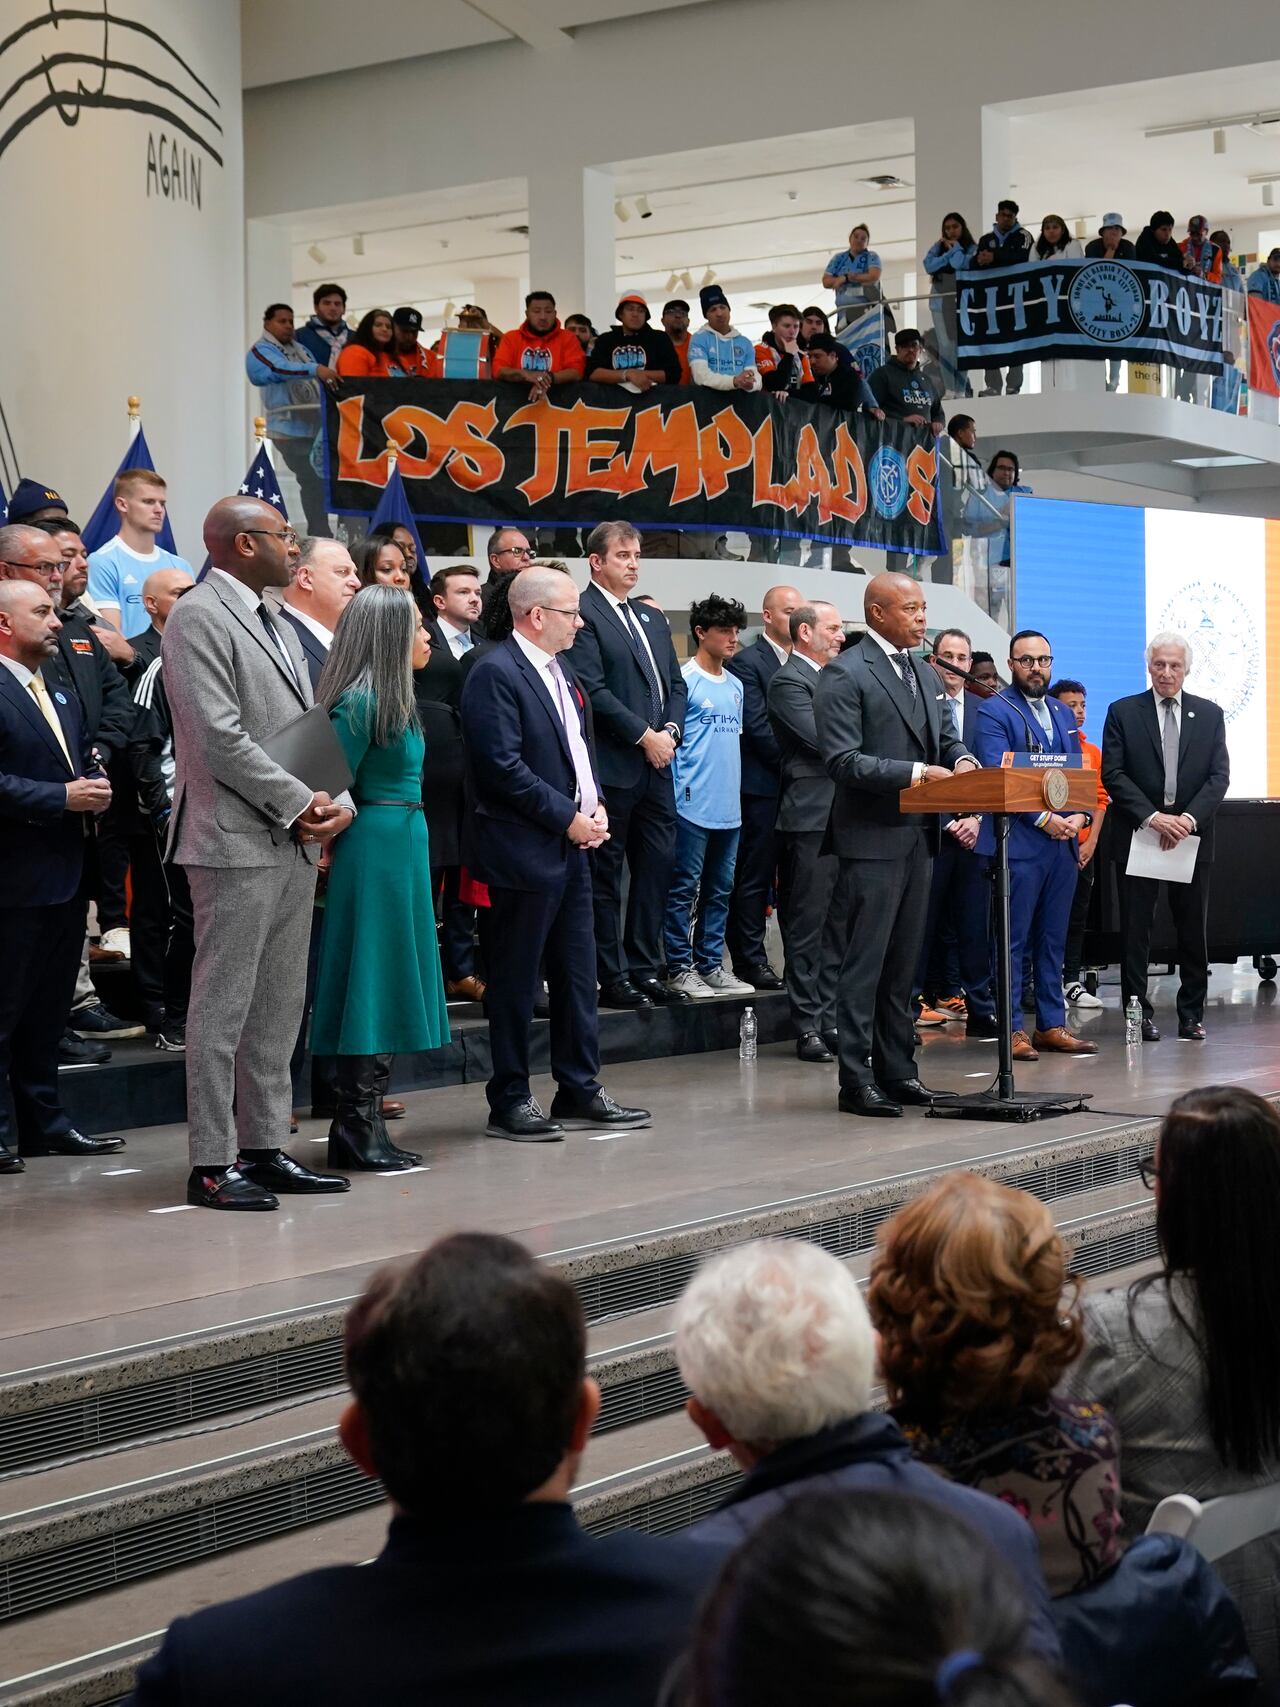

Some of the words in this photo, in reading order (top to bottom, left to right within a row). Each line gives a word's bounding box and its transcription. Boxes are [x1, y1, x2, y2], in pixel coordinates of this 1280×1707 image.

[147, 130, 202, 211] AGAIN
[1085, 278, 1097, 290] NEW
[1118, 278, 1130, 293] CITY
[959, 275, 1065, 336] CITY
[1147, 279, 1223, 342] BOYZ
[1088, 325, 1106, 338] CITY
[1134, 370, 1151, 380] the
[336, 394, 505, 492] LOS
[701, 715, 738, 724] ETIHA
